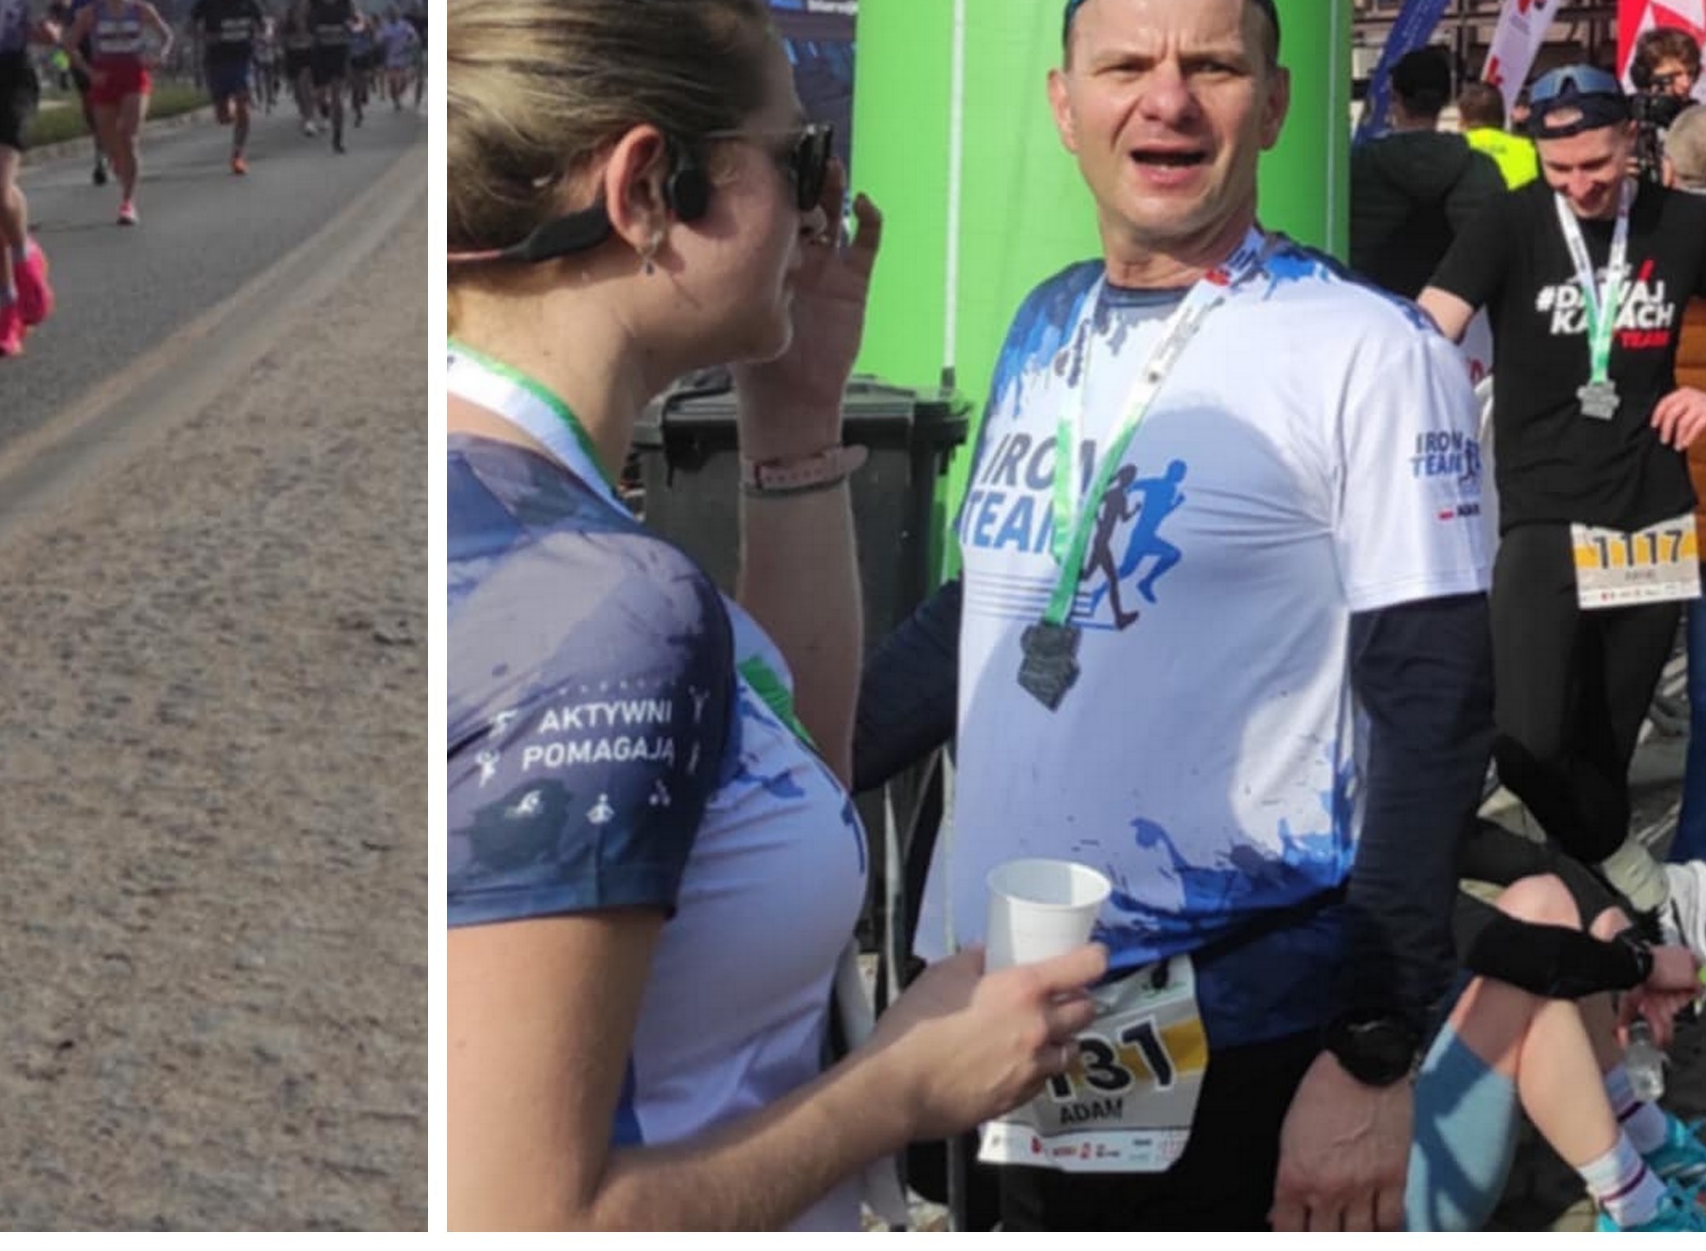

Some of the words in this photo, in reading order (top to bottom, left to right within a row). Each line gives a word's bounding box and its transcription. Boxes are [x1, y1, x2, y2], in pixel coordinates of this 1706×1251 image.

[1416, 432, 1463, 454] IRON
[1408, 452, 1463, 478] TEAM
[1593, 530, 1682, 568] 1117
[540, 699, 672, 735] AKTYWNI
[1060, 1098, 1124, 1126] ADAM
